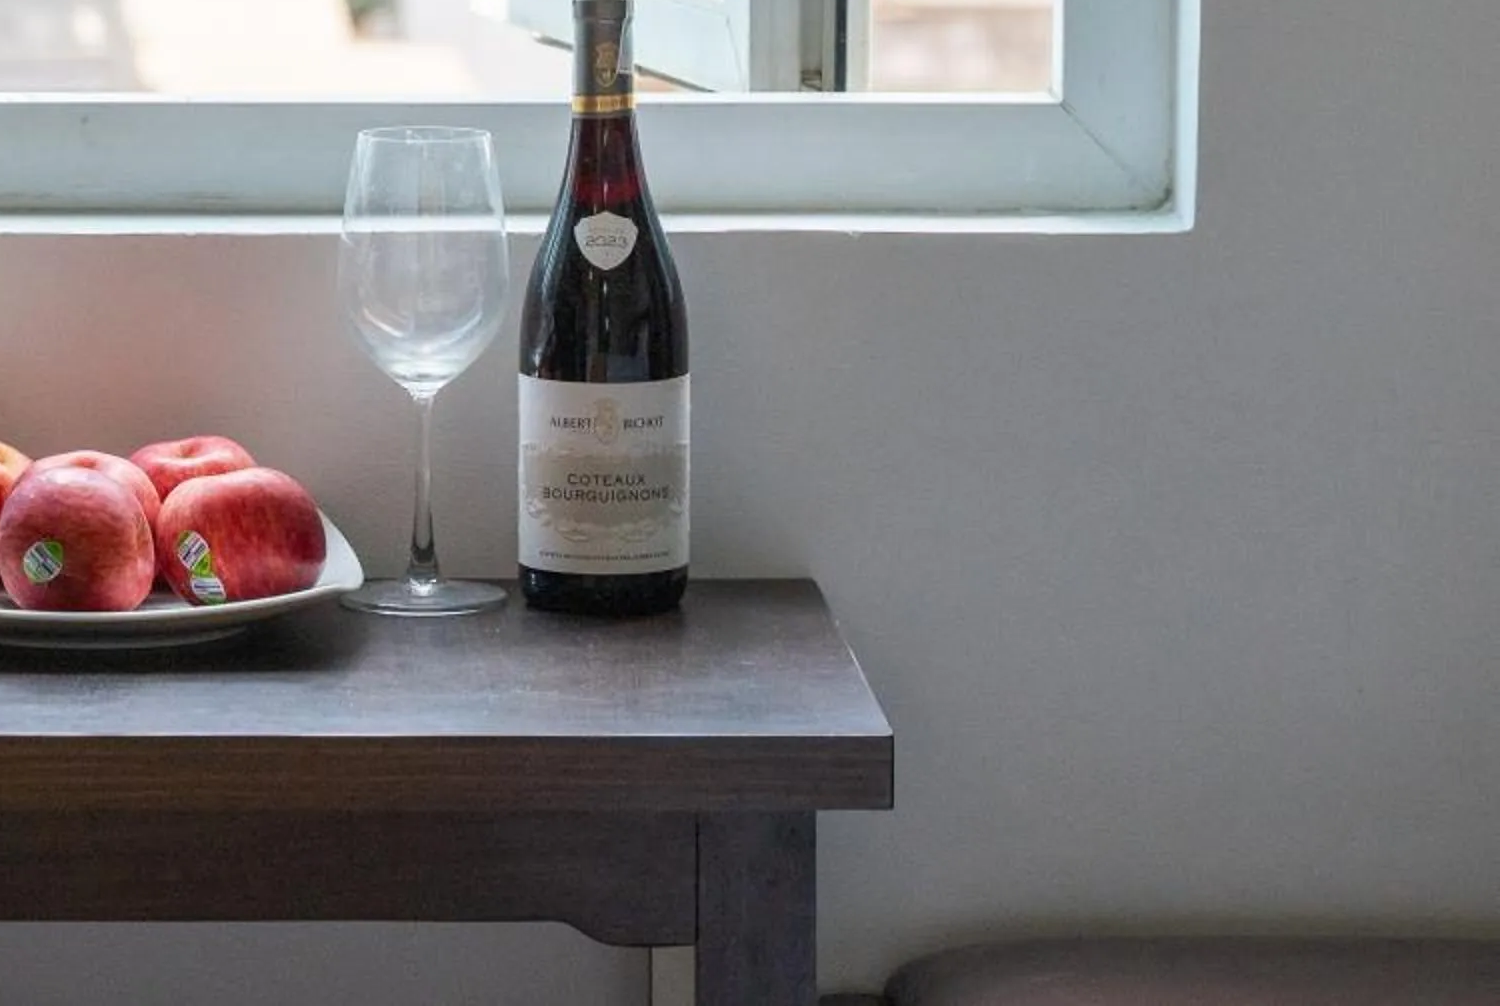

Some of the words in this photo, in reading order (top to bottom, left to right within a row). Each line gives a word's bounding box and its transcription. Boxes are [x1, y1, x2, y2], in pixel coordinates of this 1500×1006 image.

[550, 416, 592, 429] ALBERT
[567, 473, 646, 486] COTEAUX
[542, 486, 669, 503] BOURGUIGNONS
